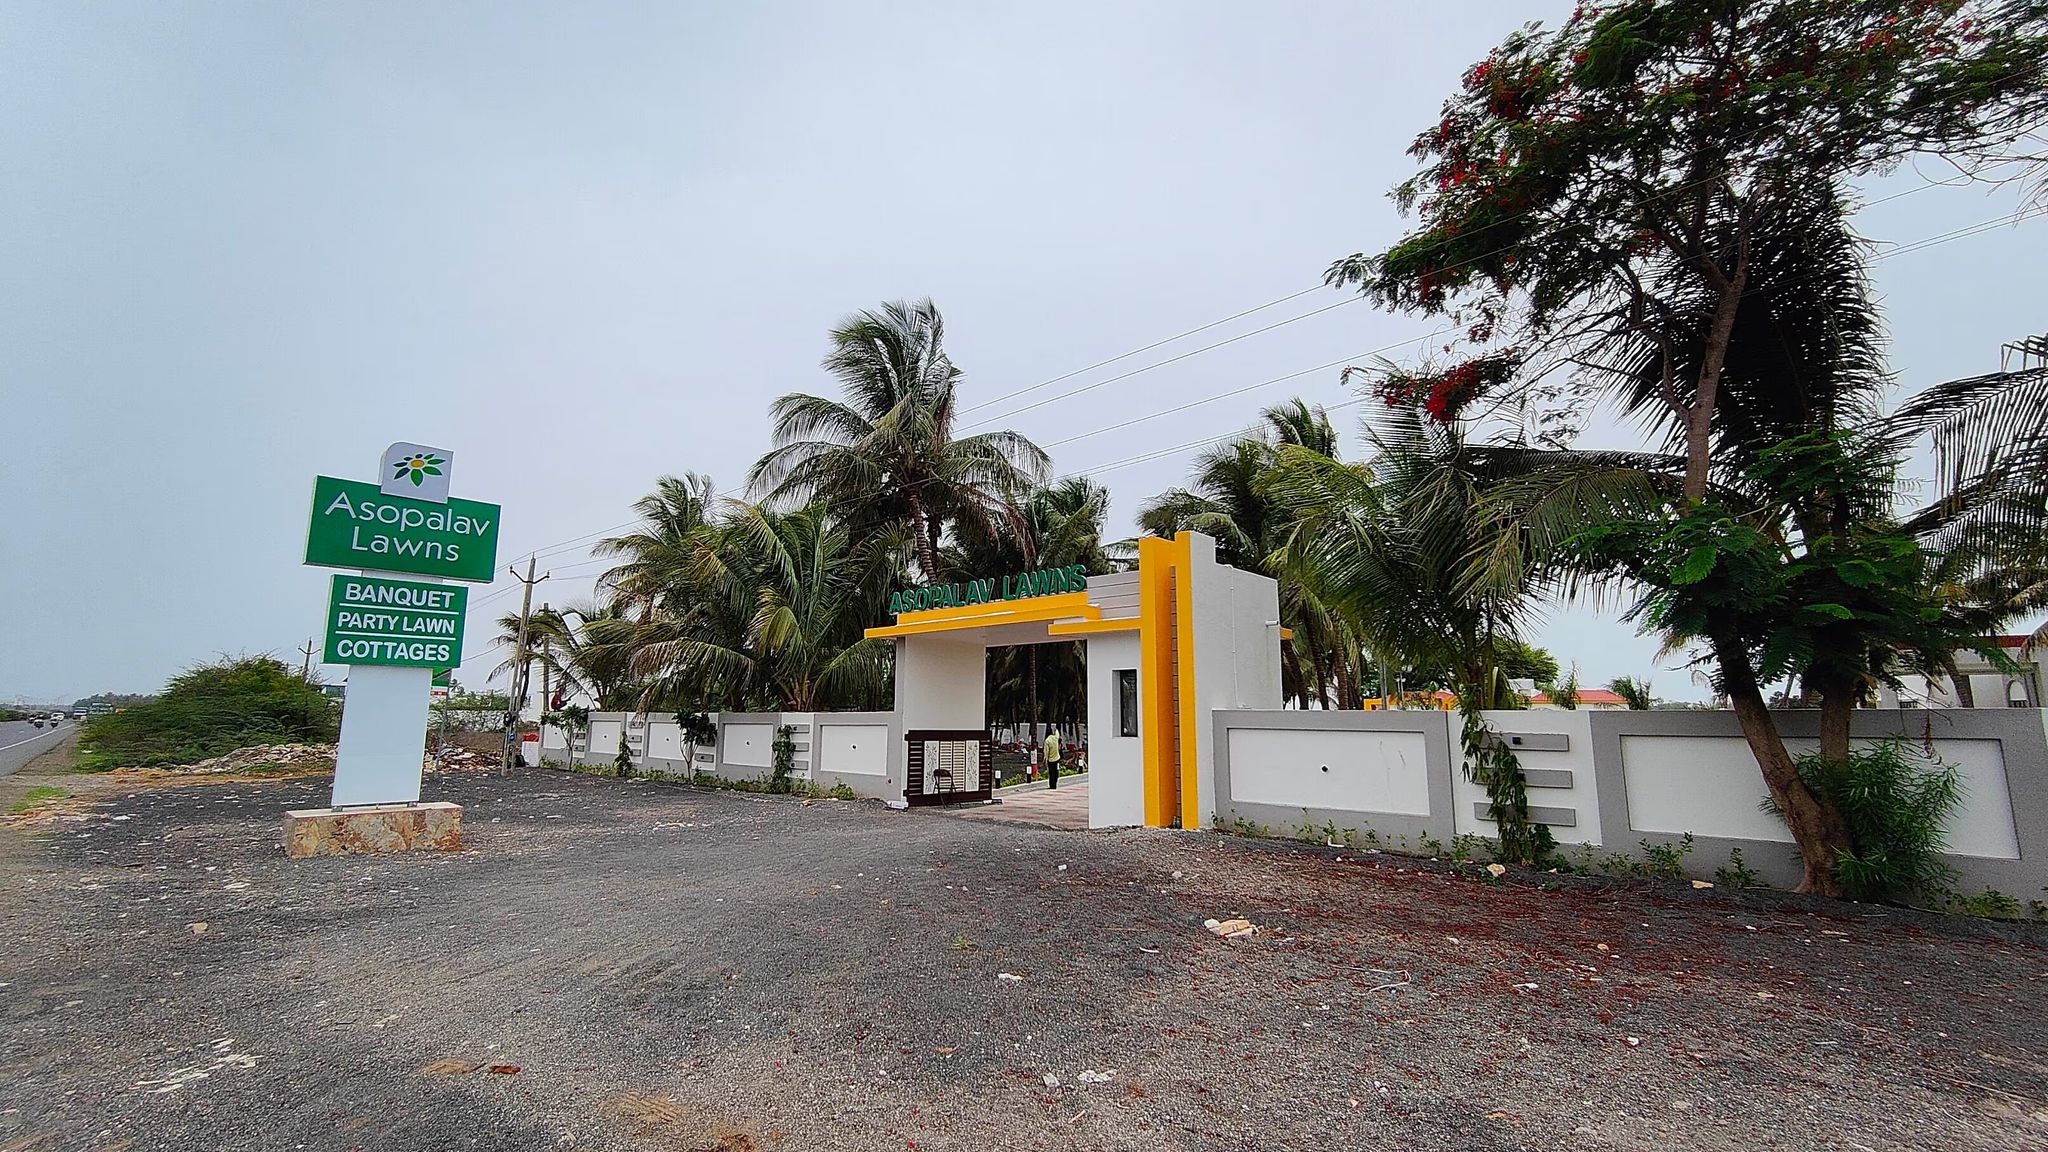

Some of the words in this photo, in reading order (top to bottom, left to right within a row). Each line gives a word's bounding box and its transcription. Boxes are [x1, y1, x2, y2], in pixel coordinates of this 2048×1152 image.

[324, 491, 490, 537] Asopalav
[351, 526, 460, 562] Lawns
[345, 583, 455, 608] BANQUET
[889, 577, 995, 614] ASOPALAV
[1002, 564, 1087, 600] LAWNS
[337, 612, 399, 630] PARTY
[402, 616, 455, 634] LAWN
[337, 639, 450, 661] COTTAGES
